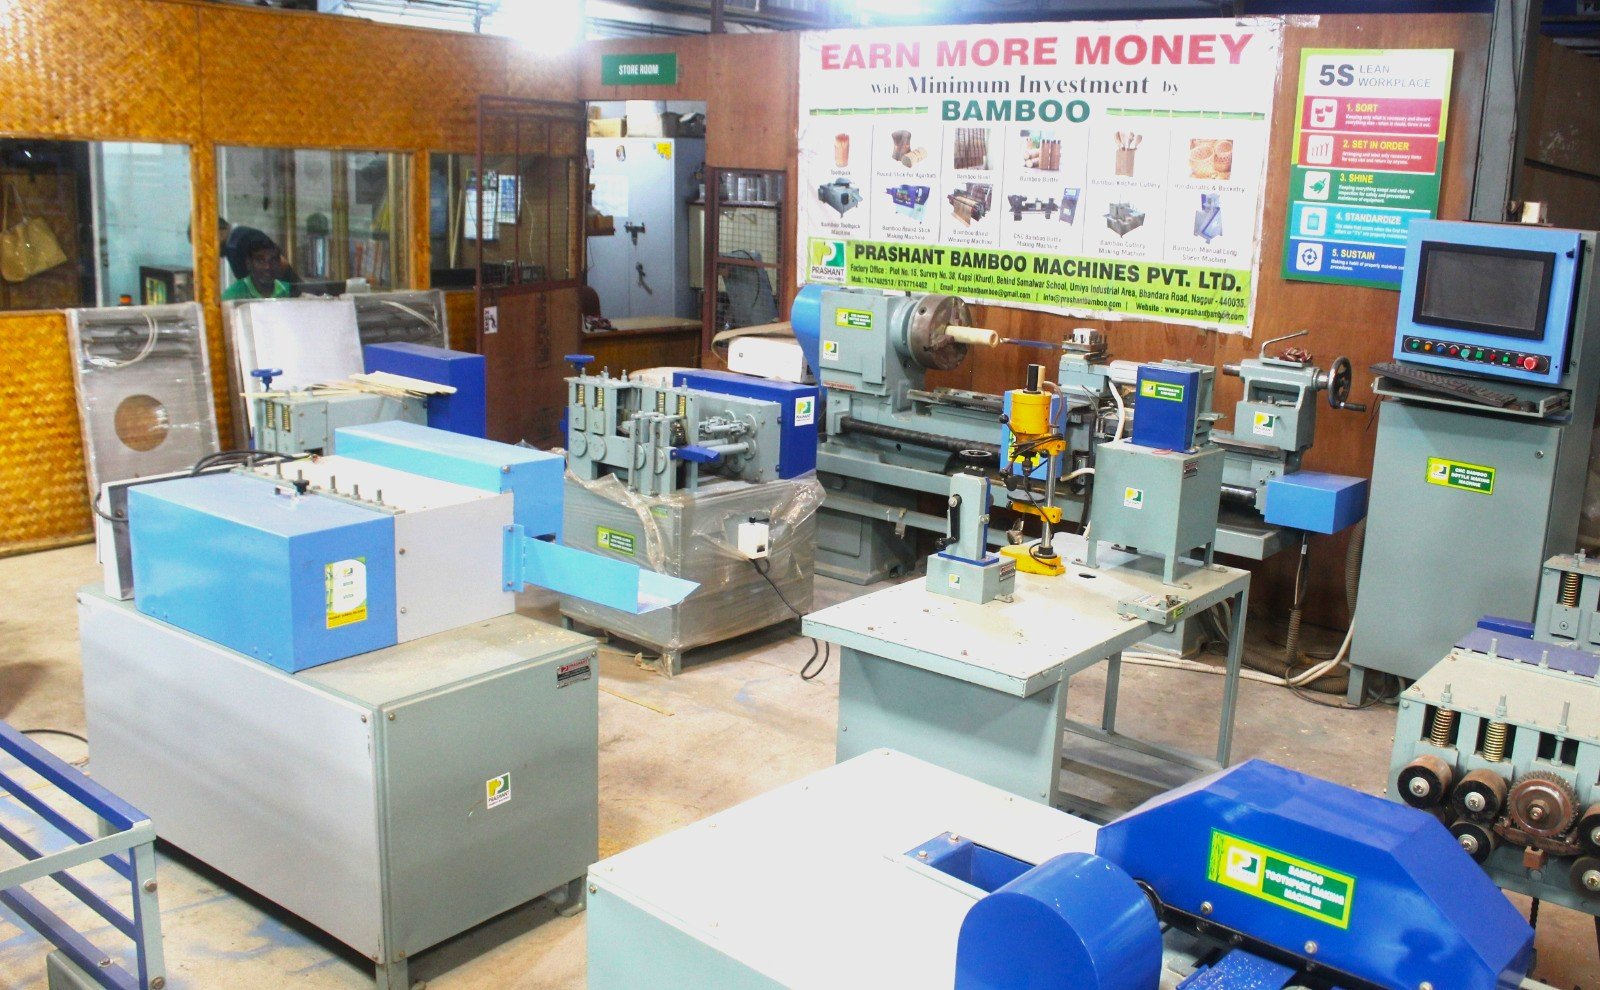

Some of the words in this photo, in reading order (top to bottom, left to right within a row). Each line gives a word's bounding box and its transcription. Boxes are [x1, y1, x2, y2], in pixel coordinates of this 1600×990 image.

[821, 42, 920, 70] EARN
[936, 37, 1058, 67] MORE
[1075, 34, 1254, 65] MONEY
[619, 64, 638, 75] STORE
[640, 64, 659, 74] ROOM
[1319, 64, 1354, 86] 5S
[1360, 65, 1389, 74] LEAN
[872, 84, 899, 94] With
[908, 76, 1009, 94] Minimum
[1020, 75, 1149, 93] Investment
[1163, 81, 1179, 95] by
[1358, 78, 1431, 88] WORKPLACE
[942, 100, 1090, 123] BAMBOO
[1355, 104, 1378, 112] SORT
[1343, 139, 1349, 148] 2.
[1352, 140, 1369, 148] SET
[1380, 142, 1409, 150] ORDER
[1340, 173, 1346, 182] 3.
[1349, 174, 1373, 183] SHINE
[1345, 213, 1401, 224] STANDARDIZE
[1332, 249, 1338, 257] 5.
[1341, 250, 1375, 260] SUSTAIN
[812, 266, 844, 276] PRASHANT
[855, 244, 944, 265] PRASHANT
[950, 250, 1026, 272] BAMBOO
[1033, 257, 1139, 282] MACHINES
[1147, 267, 1190, 287] PVT.
[1199, 271, 1241, 292] LTD.
[850, 264, 868, 273] Factory
[869, 265, 884, 274] Office
[920, 270, 938, 279] Survey
[958, 273, 972, 282] Kapsi
[997, 277, 1015, 286] Behind
[1017, 278, 1044, 288] Somalwar
[1046, 280, 1067, 291] School,
[1070, 283, 1089, 293] Umiya
[1091, 285, 1119, 295] Industrial
[1121, 287, 1137, 298] Area,
[1139, 289, 1169, 301] Bhandara
[1171, 292, 1189, 303] Road,
[1192, 294, 1214, 306] Nagpur
[1136, 302, 1159, 312] Website
[1288, 865, 1324, 885] BAMBOO
[1265, 869, 1311, 893] TOOTHPICK
[1311, 886, 1344, 906] MAKING
[1284, 888, 1322, 909] MACHINE
